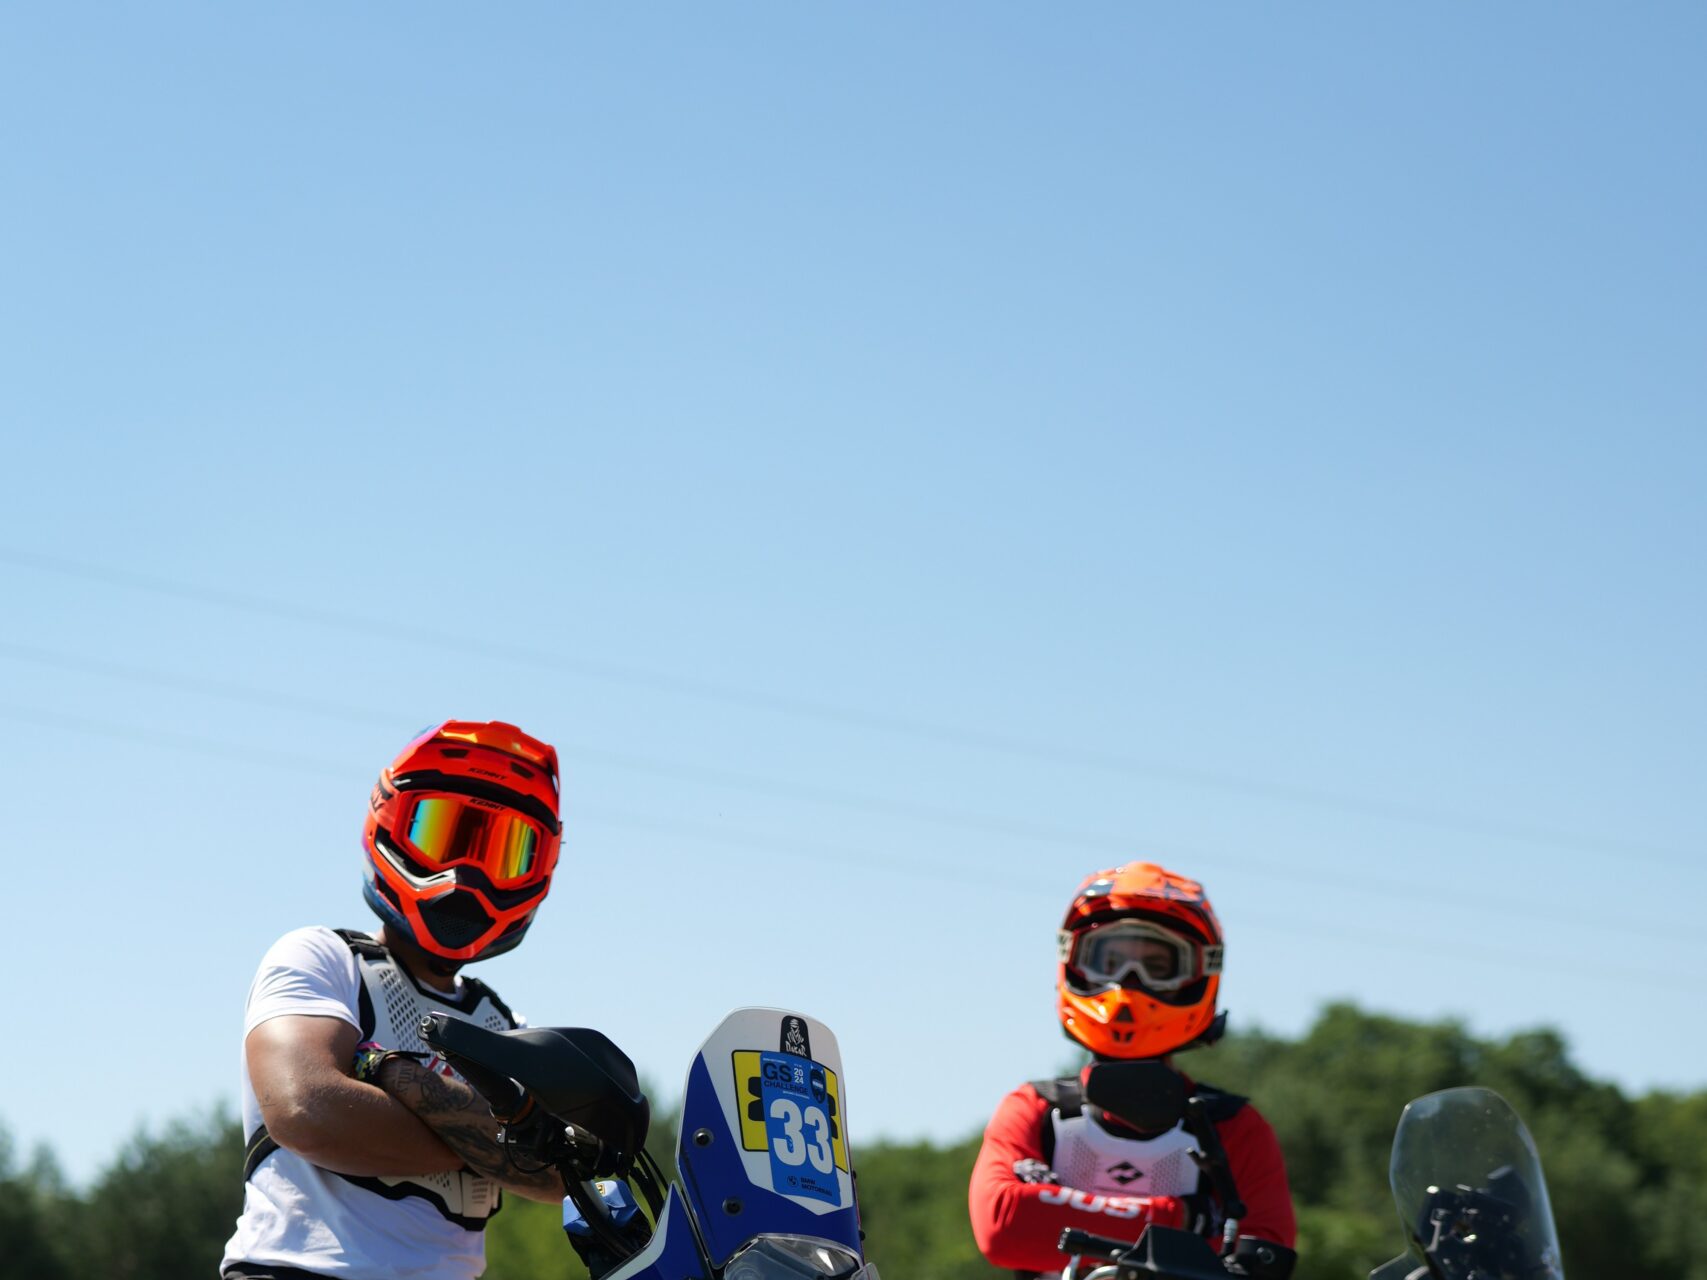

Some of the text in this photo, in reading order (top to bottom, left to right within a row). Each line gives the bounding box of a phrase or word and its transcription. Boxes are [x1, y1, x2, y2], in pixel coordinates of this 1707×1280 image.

[469, 767, 507, 780] KENNY
[470, 798, 506, 811] KENNY
[763, 1062, 792, 1082] GS
[764, 1080, 808, 1095] CHALLENGE
[770, 1098, 833, 1175] 33
